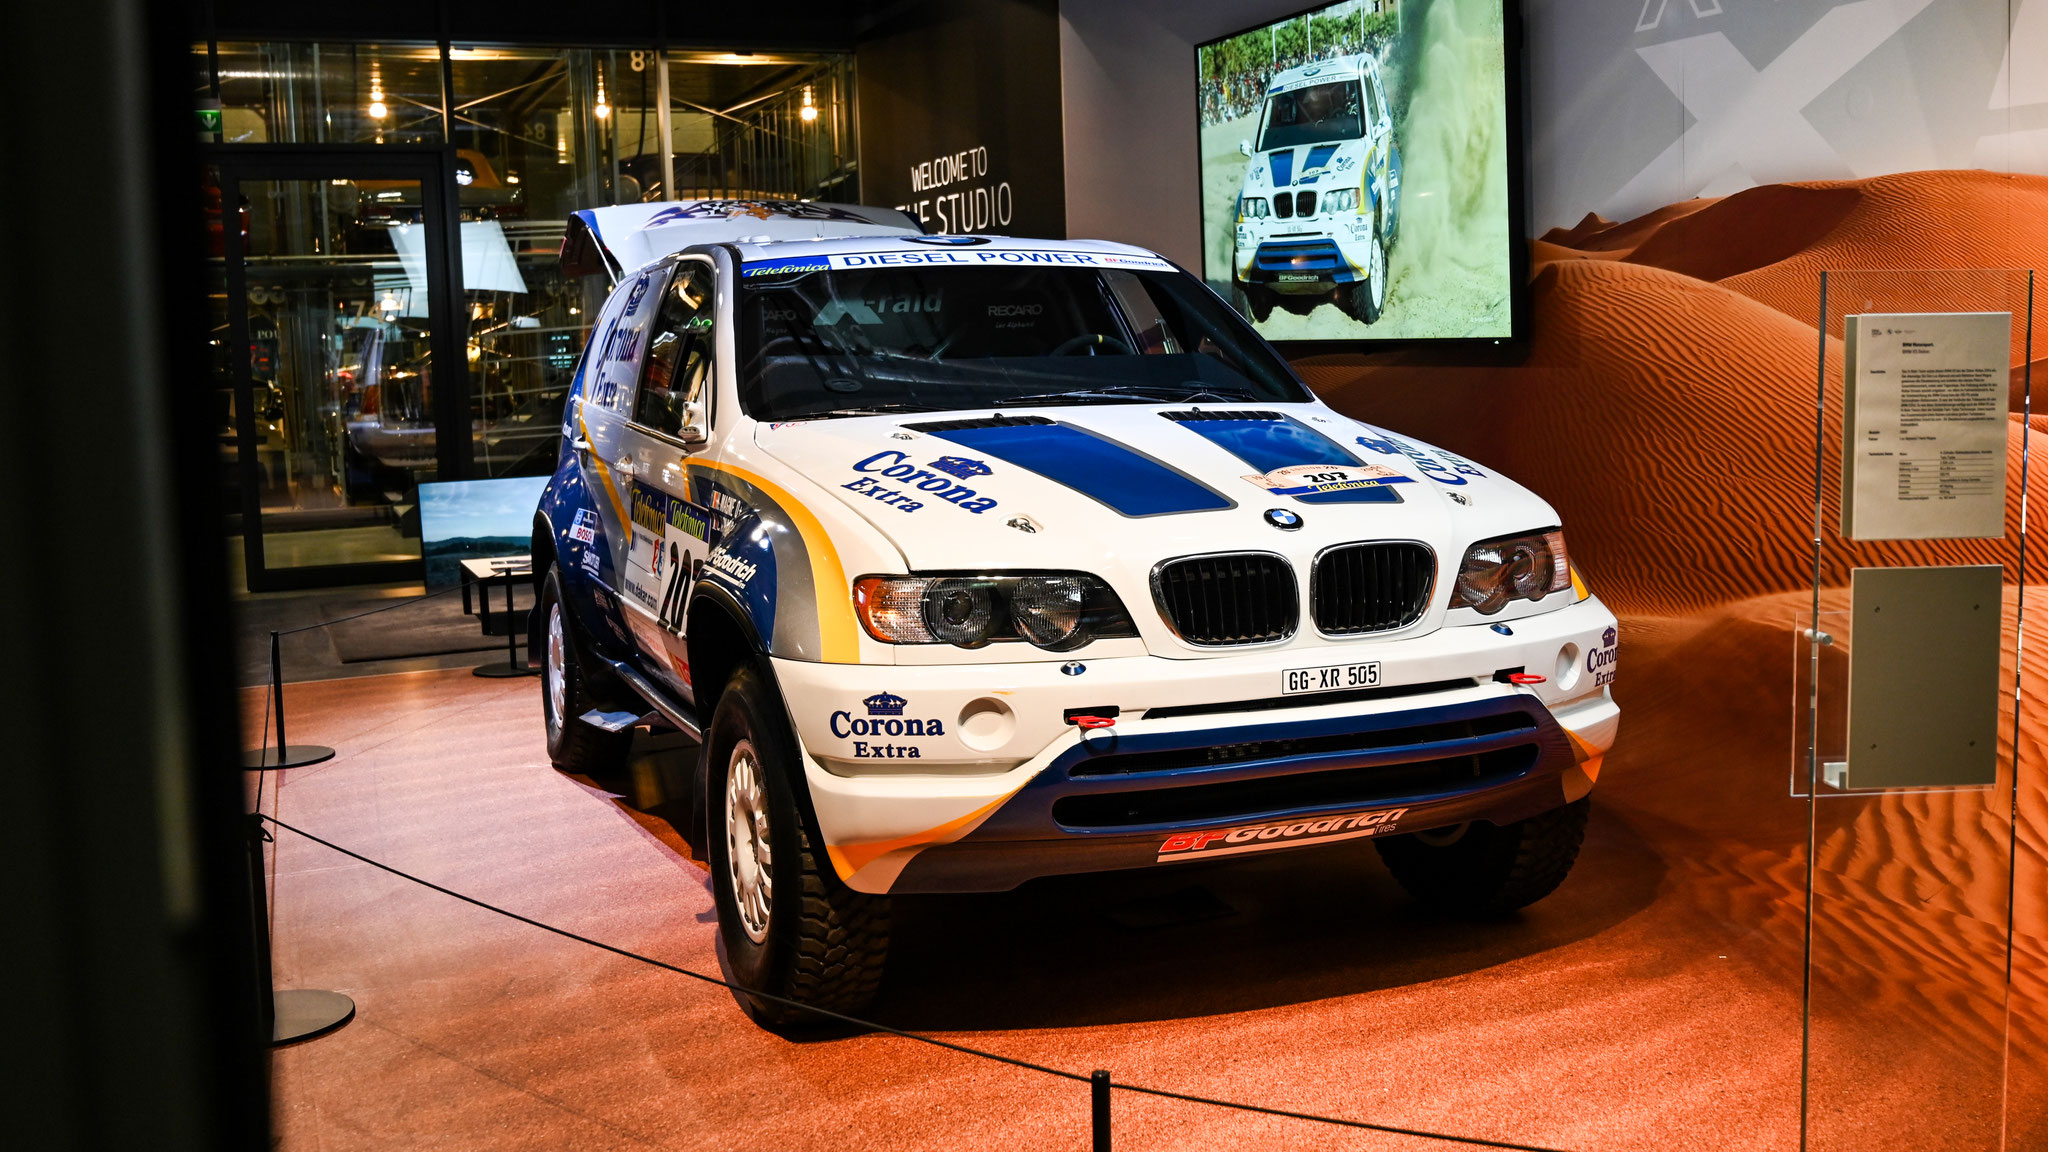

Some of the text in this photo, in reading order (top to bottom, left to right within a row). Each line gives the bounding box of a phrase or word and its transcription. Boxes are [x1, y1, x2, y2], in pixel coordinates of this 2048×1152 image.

[1309, 75, 1337, 85] POWER
[911, 146, 988, 193] WELCOME TO
[936, 182, 1013, 236] STUDIO
[843, 252, 968, 266] DIESEL
[976, 252, 1100, 265] POWER
[1104, 257, 1169, 268] BFGoodrich
[988, 303, 1043, 317] RECARO
[597, 317, 641, 369] Corona
[852, 449, 999, 515] Corona
[1303, 471, 1350, 484] 207
[840, 476, 924, 513] Extra
[1348, 664, 1378, 686] 505
[830, 710, 945, 739] Corona
[853, 741, 921, 758] Extra
[1158, 808, 1410, 854] BFGoodrich
[1373, 823, 1397, 835] Tires
